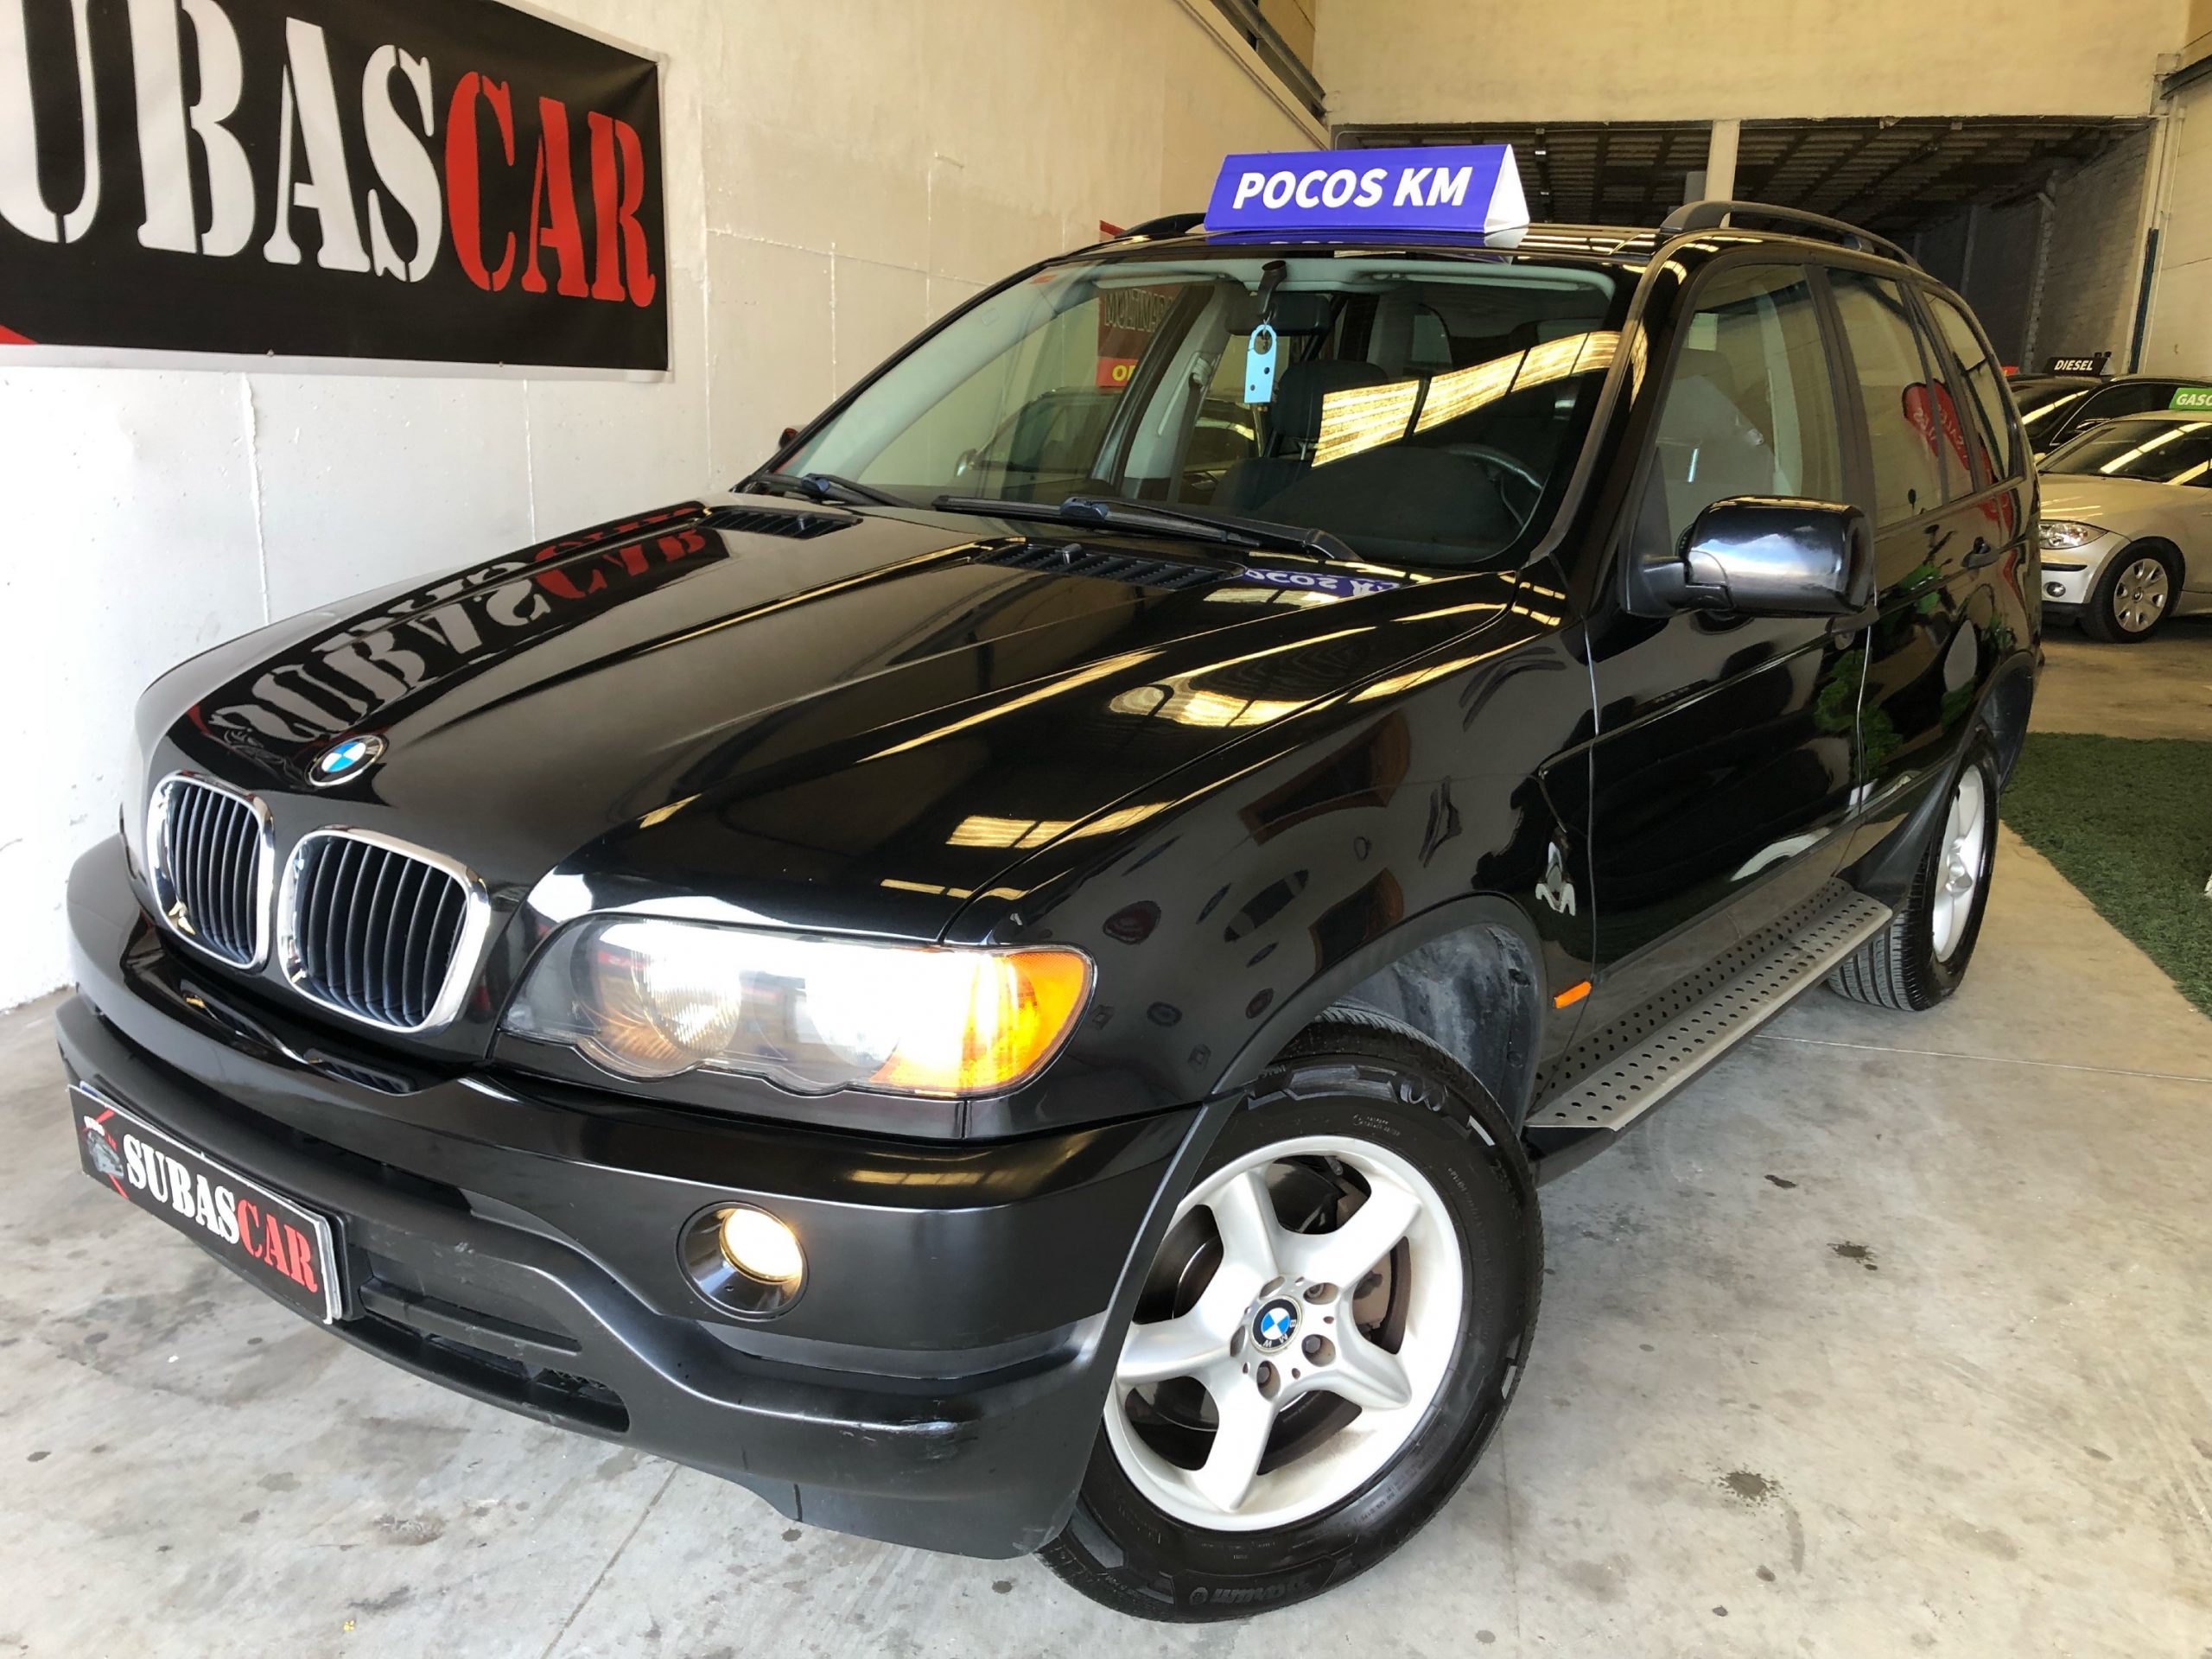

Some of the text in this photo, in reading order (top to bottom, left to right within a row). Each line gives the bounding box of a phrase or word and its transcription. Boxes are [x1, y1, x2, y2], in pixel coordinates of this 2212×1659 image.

[1232, 166, 1473, 210] POCOS KM
[2054, 359, 2093, 371] DIESEL
[123, 1134, 318, 1293] SUBASCAR
[1262, 1319, 1297, 1348] BMW
